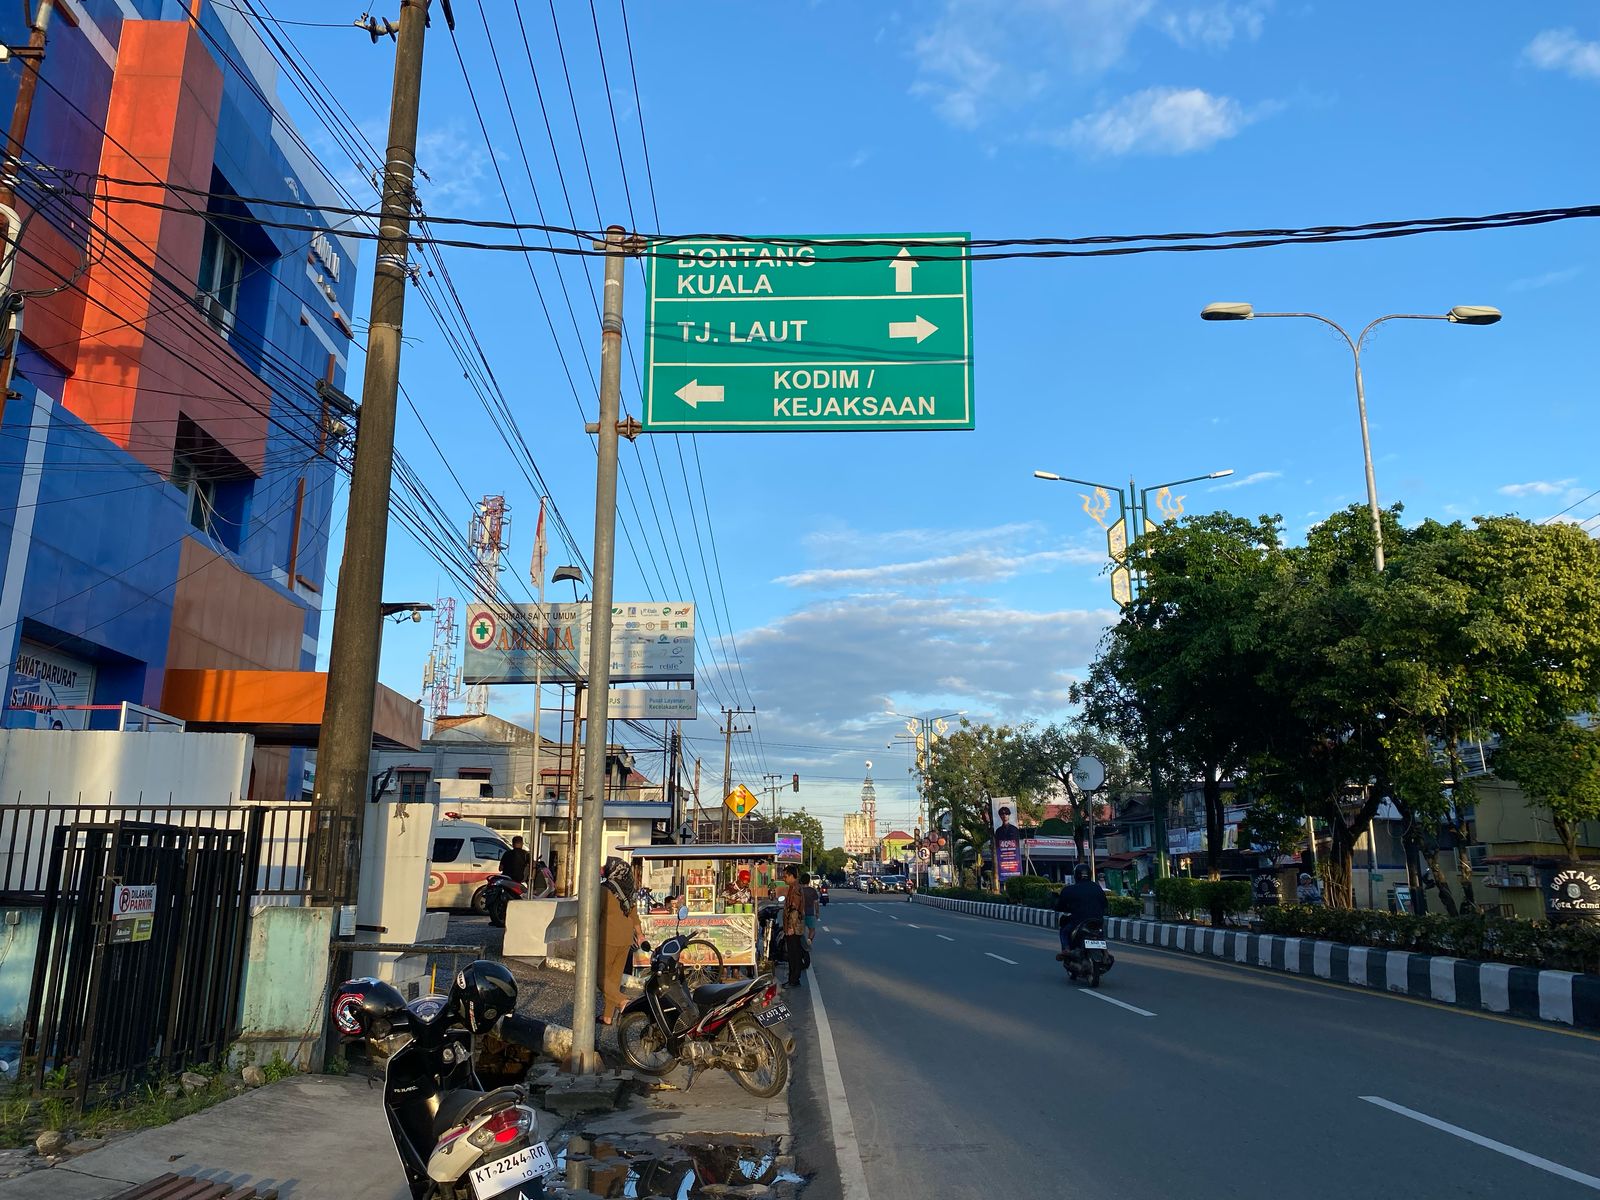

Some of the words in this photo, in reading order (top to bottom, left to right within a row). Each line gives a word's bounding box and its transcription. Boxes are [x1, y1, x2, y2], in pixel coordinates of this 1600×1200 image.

[678, 247, 816, 268] BONTANG
[677, 274, 774, 294] KUALA
[677, 321, 720, 343] TJ.
[729, 320, 808, 343] LAUT
[774, 369, 859, 389] KODIM
[866, 369, 875, 389] /
[773, 396, 935, 417] KEJAKSAAN
[528, 612, 550, 620] SAIT
[553, 612, 577, 620] UMUM
[16, 654, 40, 678] AWAT
[40, 662, 77, 688] DARURAT
[1550, 870, 1600, 891] BONTANG
[130, 899, 152, 911] PARKIR
[1550, 898, 1572, 910] Kota
[475, 1166, 492, 1183] KT
[496, 1153, 527, 1174] 2244
[529, 1145, 546, 1159] RR
